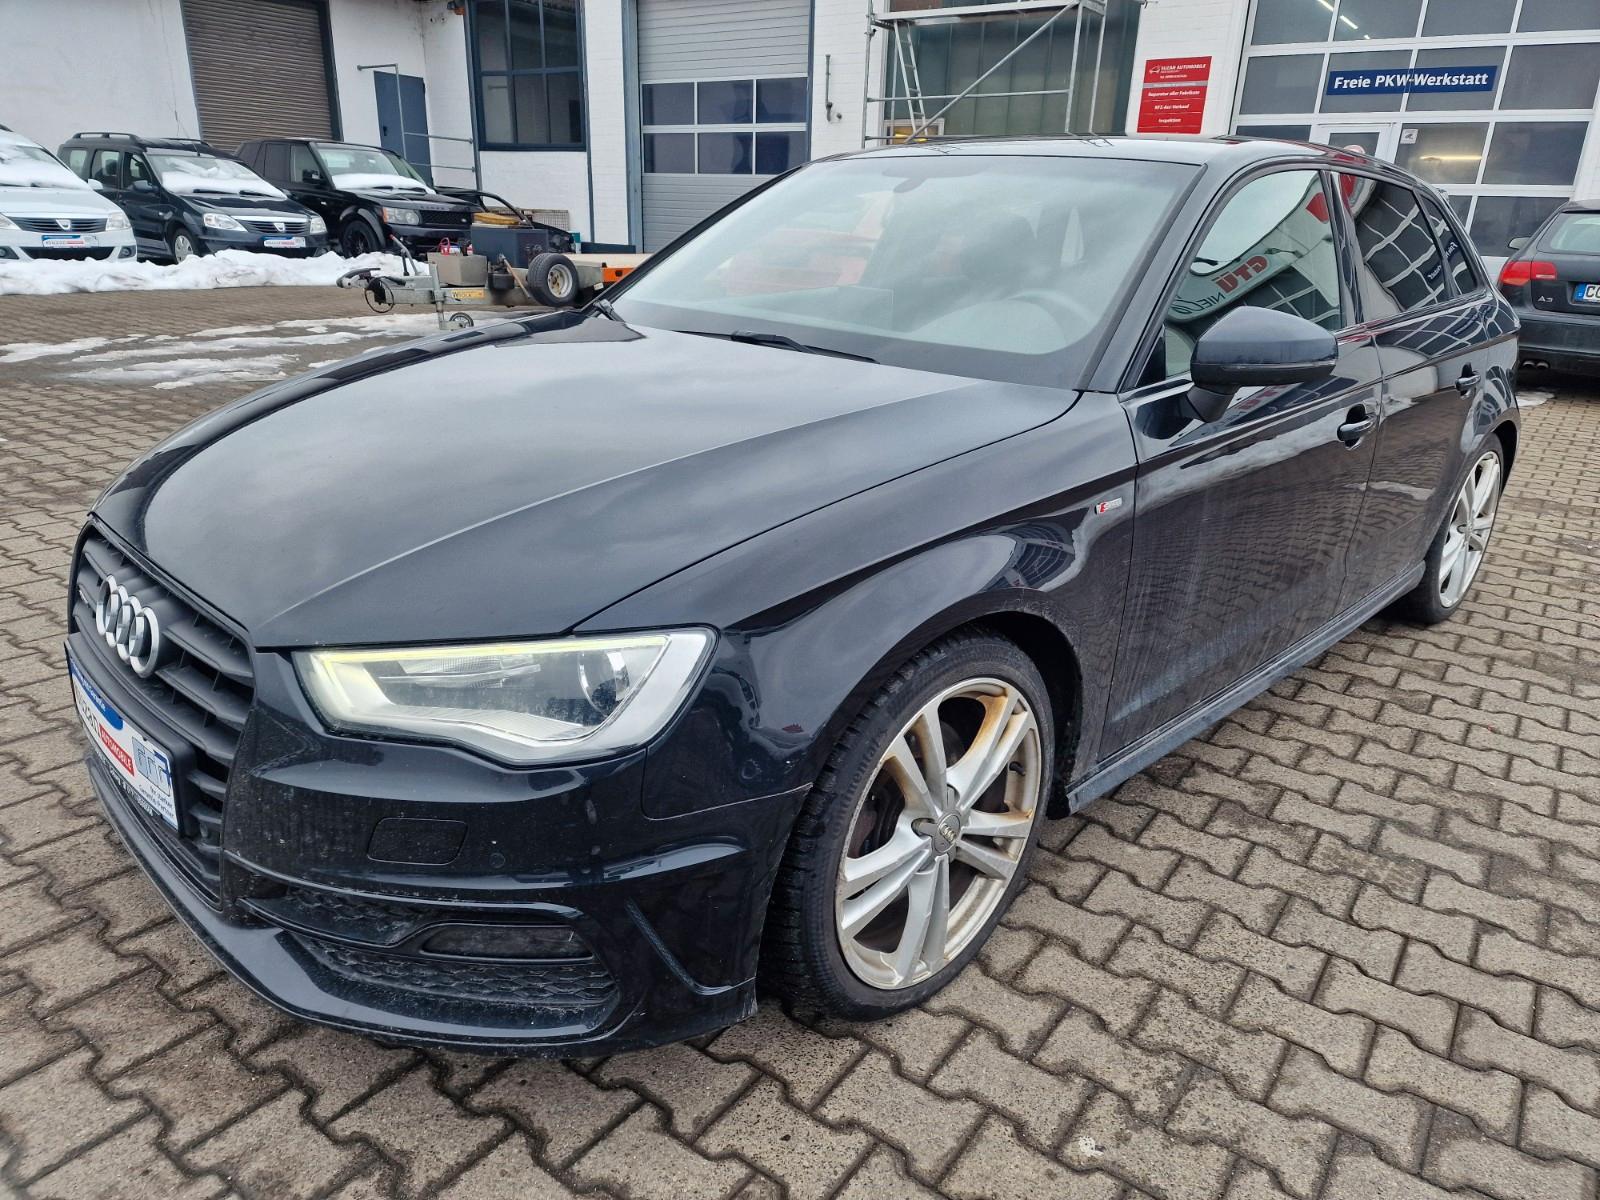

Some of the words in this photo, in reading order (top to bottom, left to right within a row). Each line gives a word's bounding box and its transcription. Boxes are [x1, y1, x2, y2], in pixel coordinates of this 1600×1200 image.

[1334, 75, 1370, 89] Freie
[1374, 72, 1489, 88] PKW-Werkstatt
[1537, 295, 1554, 303] A3
